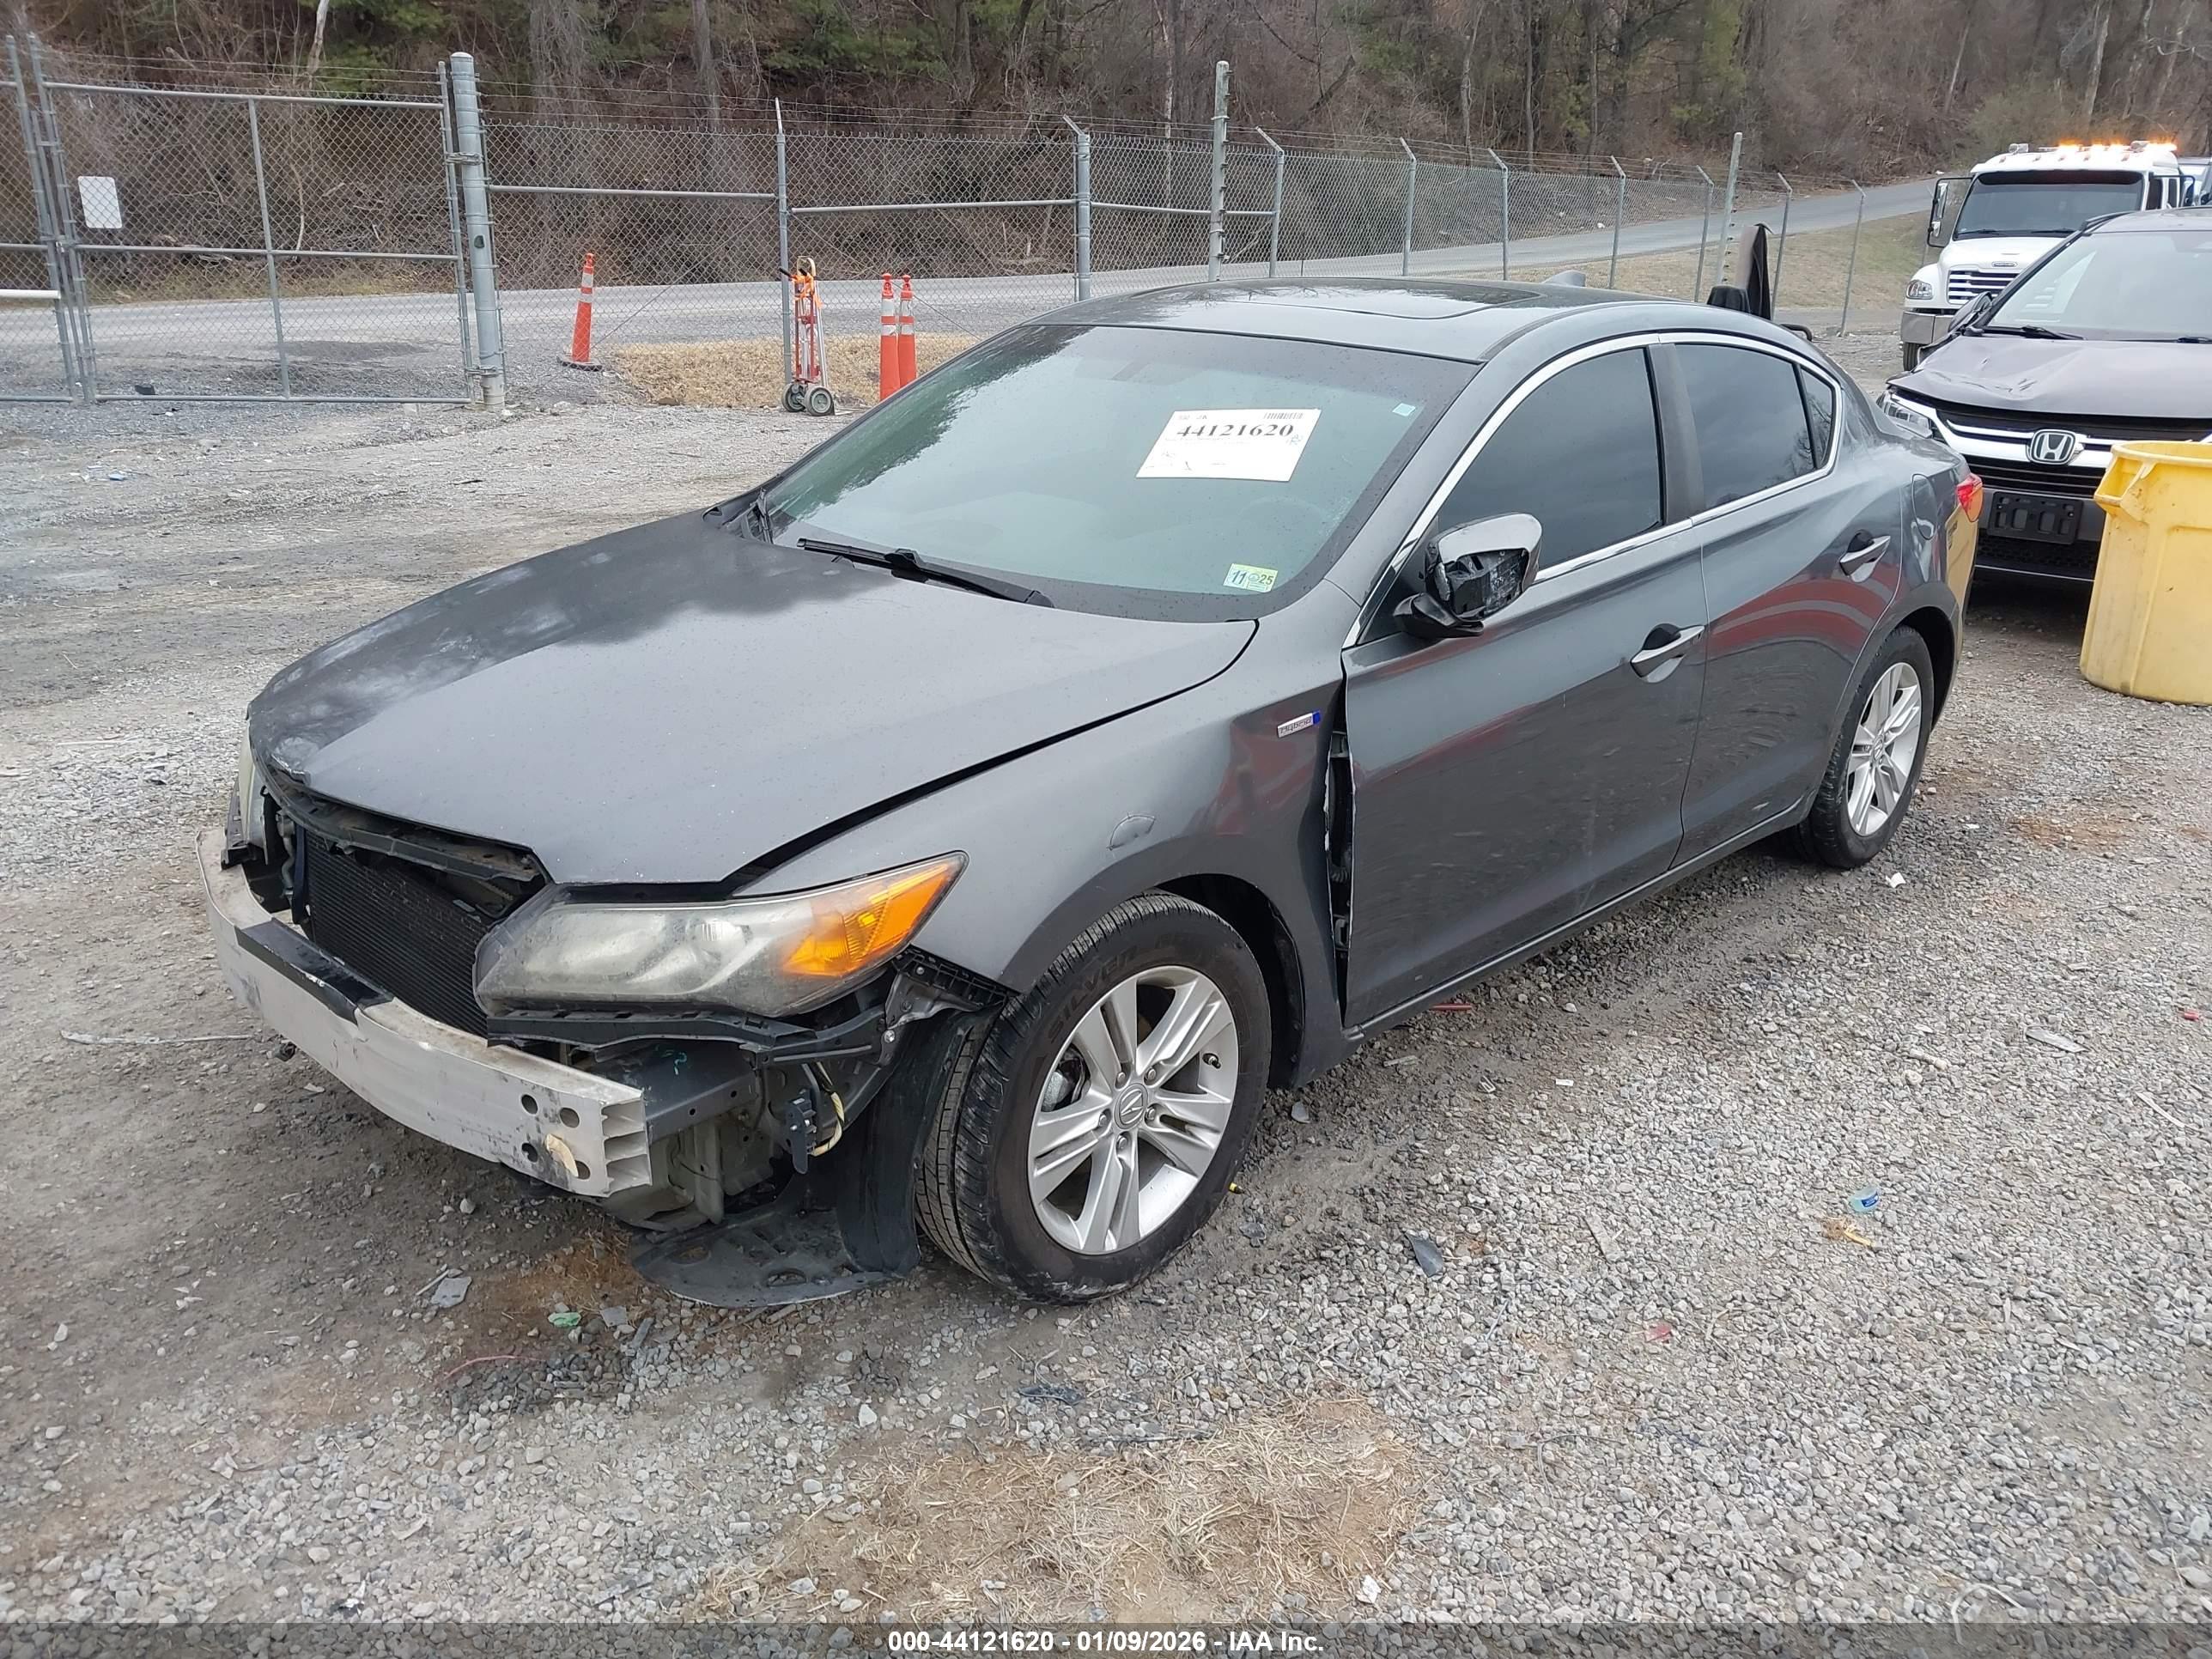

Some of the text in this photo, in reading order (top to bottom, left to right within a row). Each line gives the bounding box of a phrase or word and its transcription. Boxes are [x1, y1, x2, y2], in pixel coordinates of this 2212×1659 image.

[1176, 424, 1294, 437] 44121620
[1231, 570, 1274, 586] 11 25
